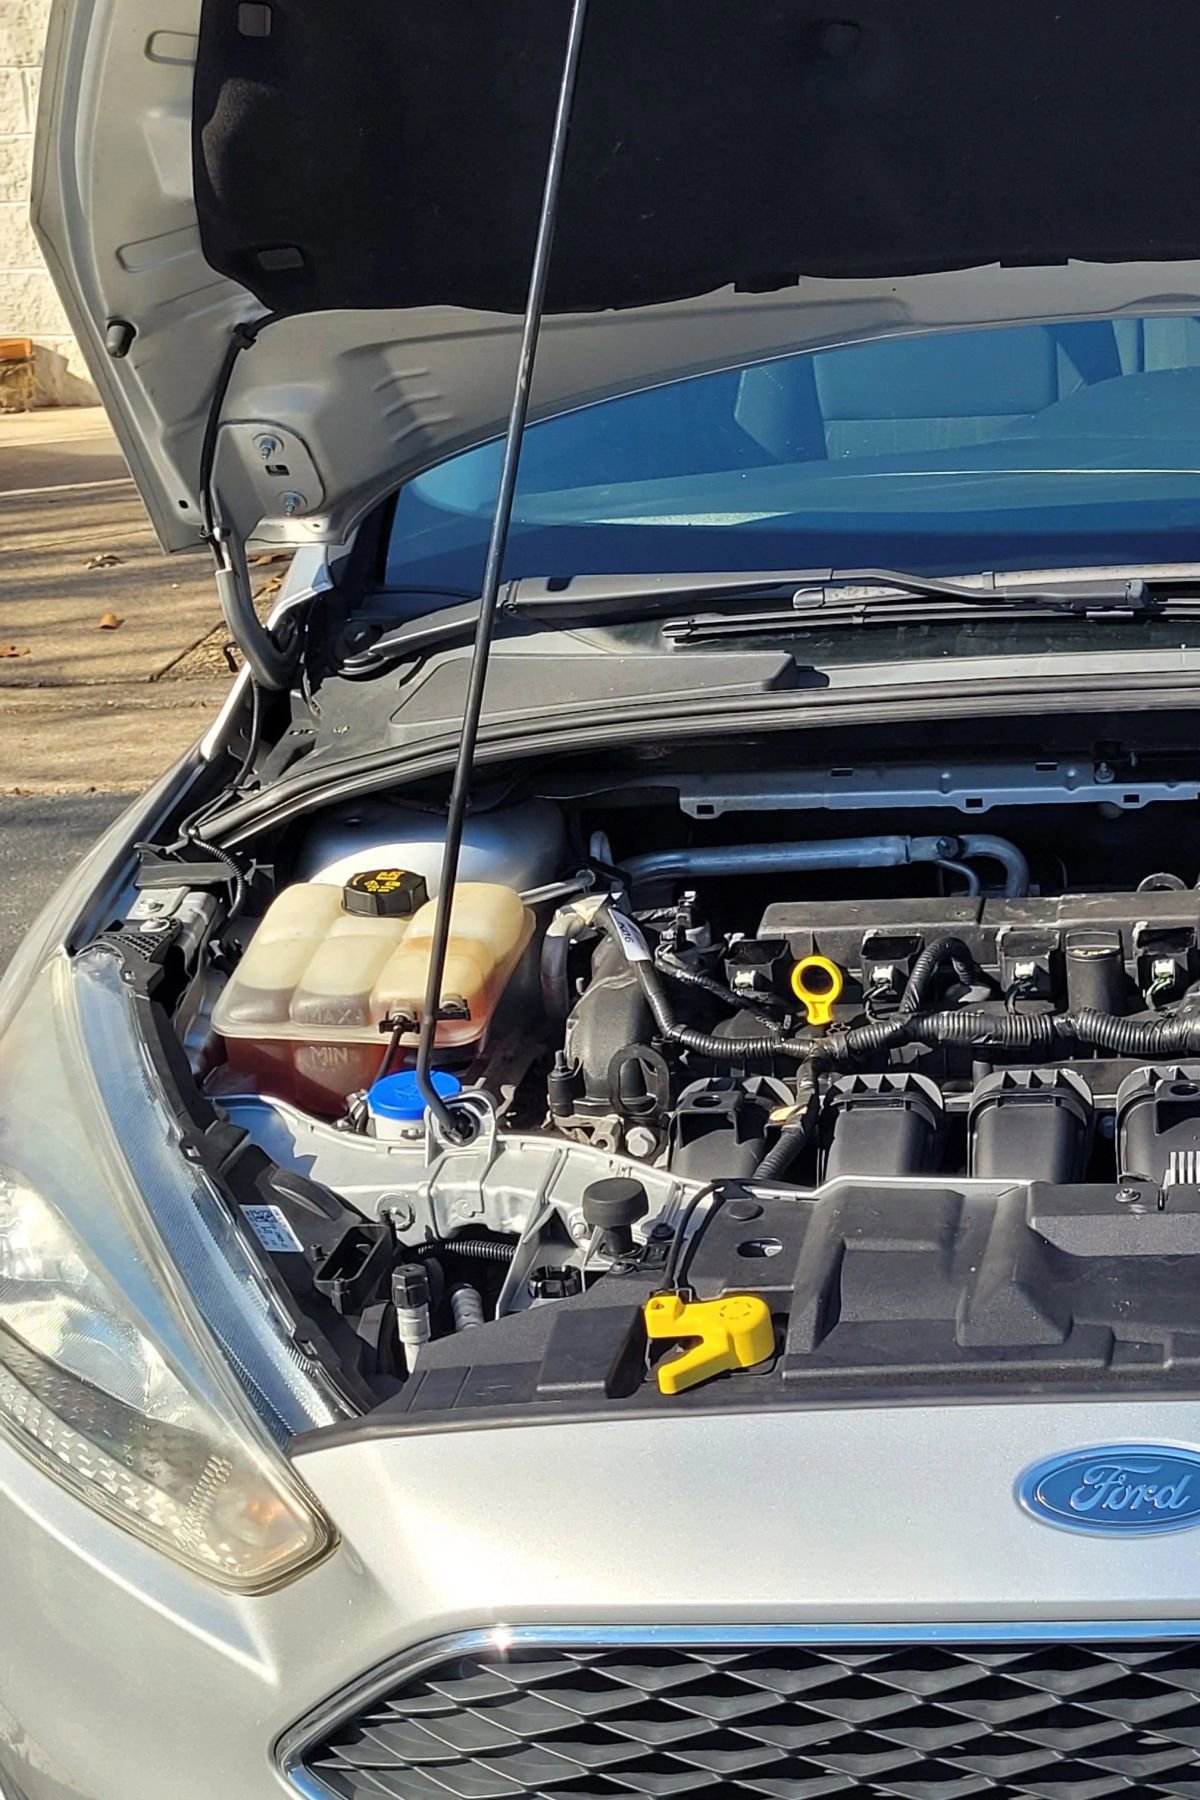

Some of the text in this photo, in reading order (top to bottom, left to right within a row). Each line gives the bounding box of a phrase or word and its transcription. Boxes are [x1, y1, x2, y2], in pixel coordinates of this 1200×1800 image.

[304, 1007, 352, 1025] MAX
[309, 1046, 349, 1067] MIN
[1069, 1464, 1193, 1512] Ford
